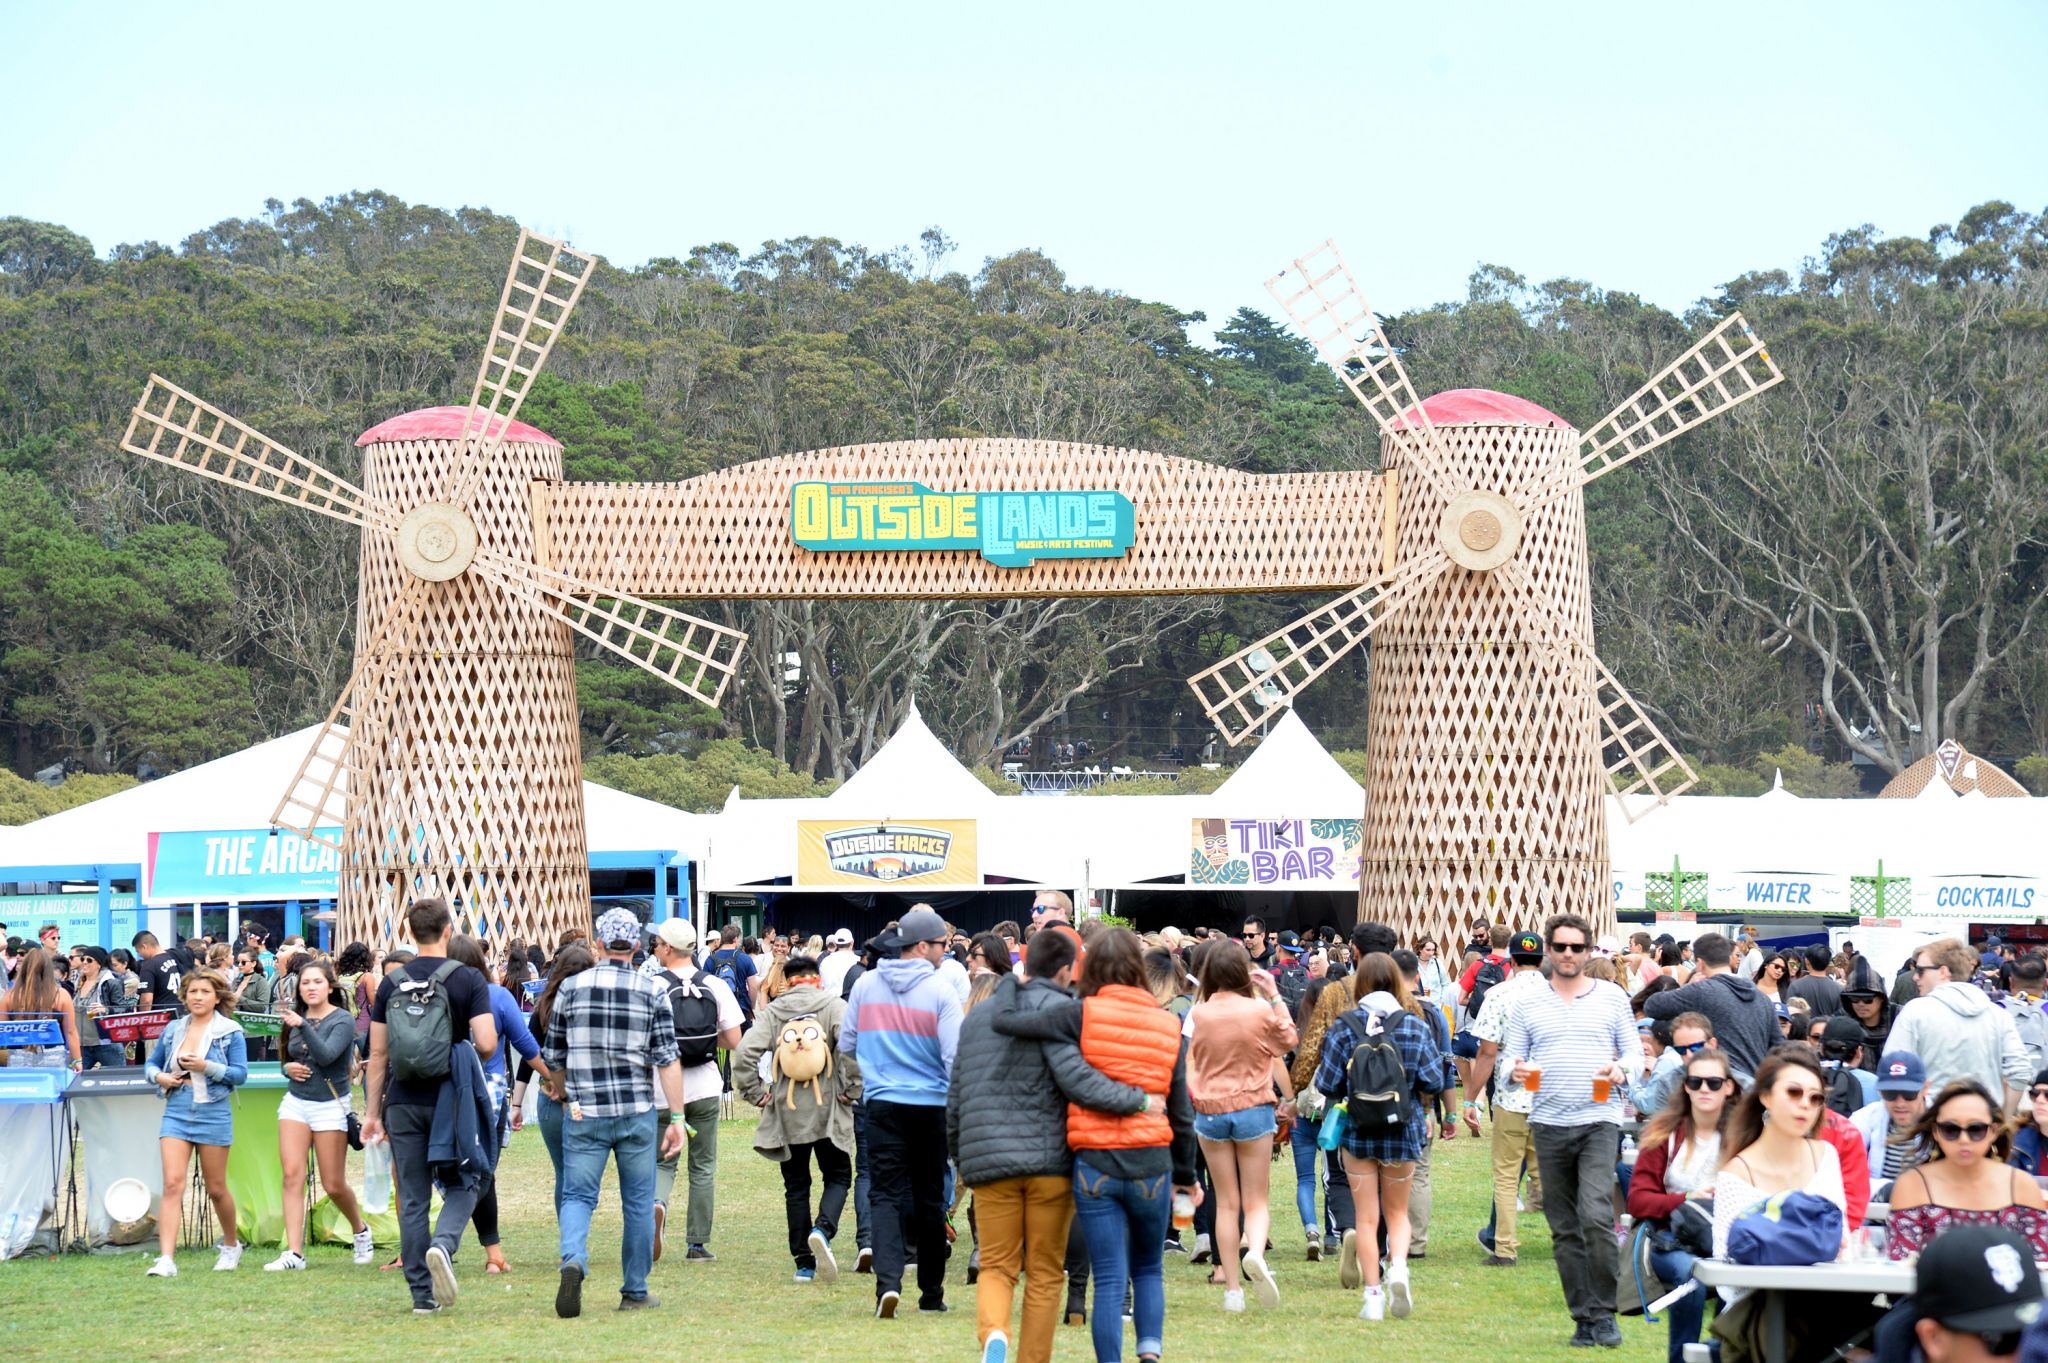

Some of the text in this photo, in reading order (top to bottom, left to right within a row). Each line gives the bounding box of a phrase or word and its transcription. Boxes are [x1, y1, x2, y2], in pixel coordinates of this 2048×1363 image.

[830, 485, 913, 495] SAN FRANCISCO'S
[795, 483, 1117, 555] OUTSIDE LANDS
[1074, 539, 1114, 549] FESTIVAL
[1230, 819, 1304, 853] TIKI
[205, 836, 256, 876] THE
[1252, 846, 1335, 885] BAR
[1747, 882, 1811, 904] WATER
[1937, 886, 2035, 908] COCKTAILS
[33, 900, 66, 916] LANDS
[69, 899, 95, 915] 2016
[104, 1014, 168, 1029] LANDFILL
